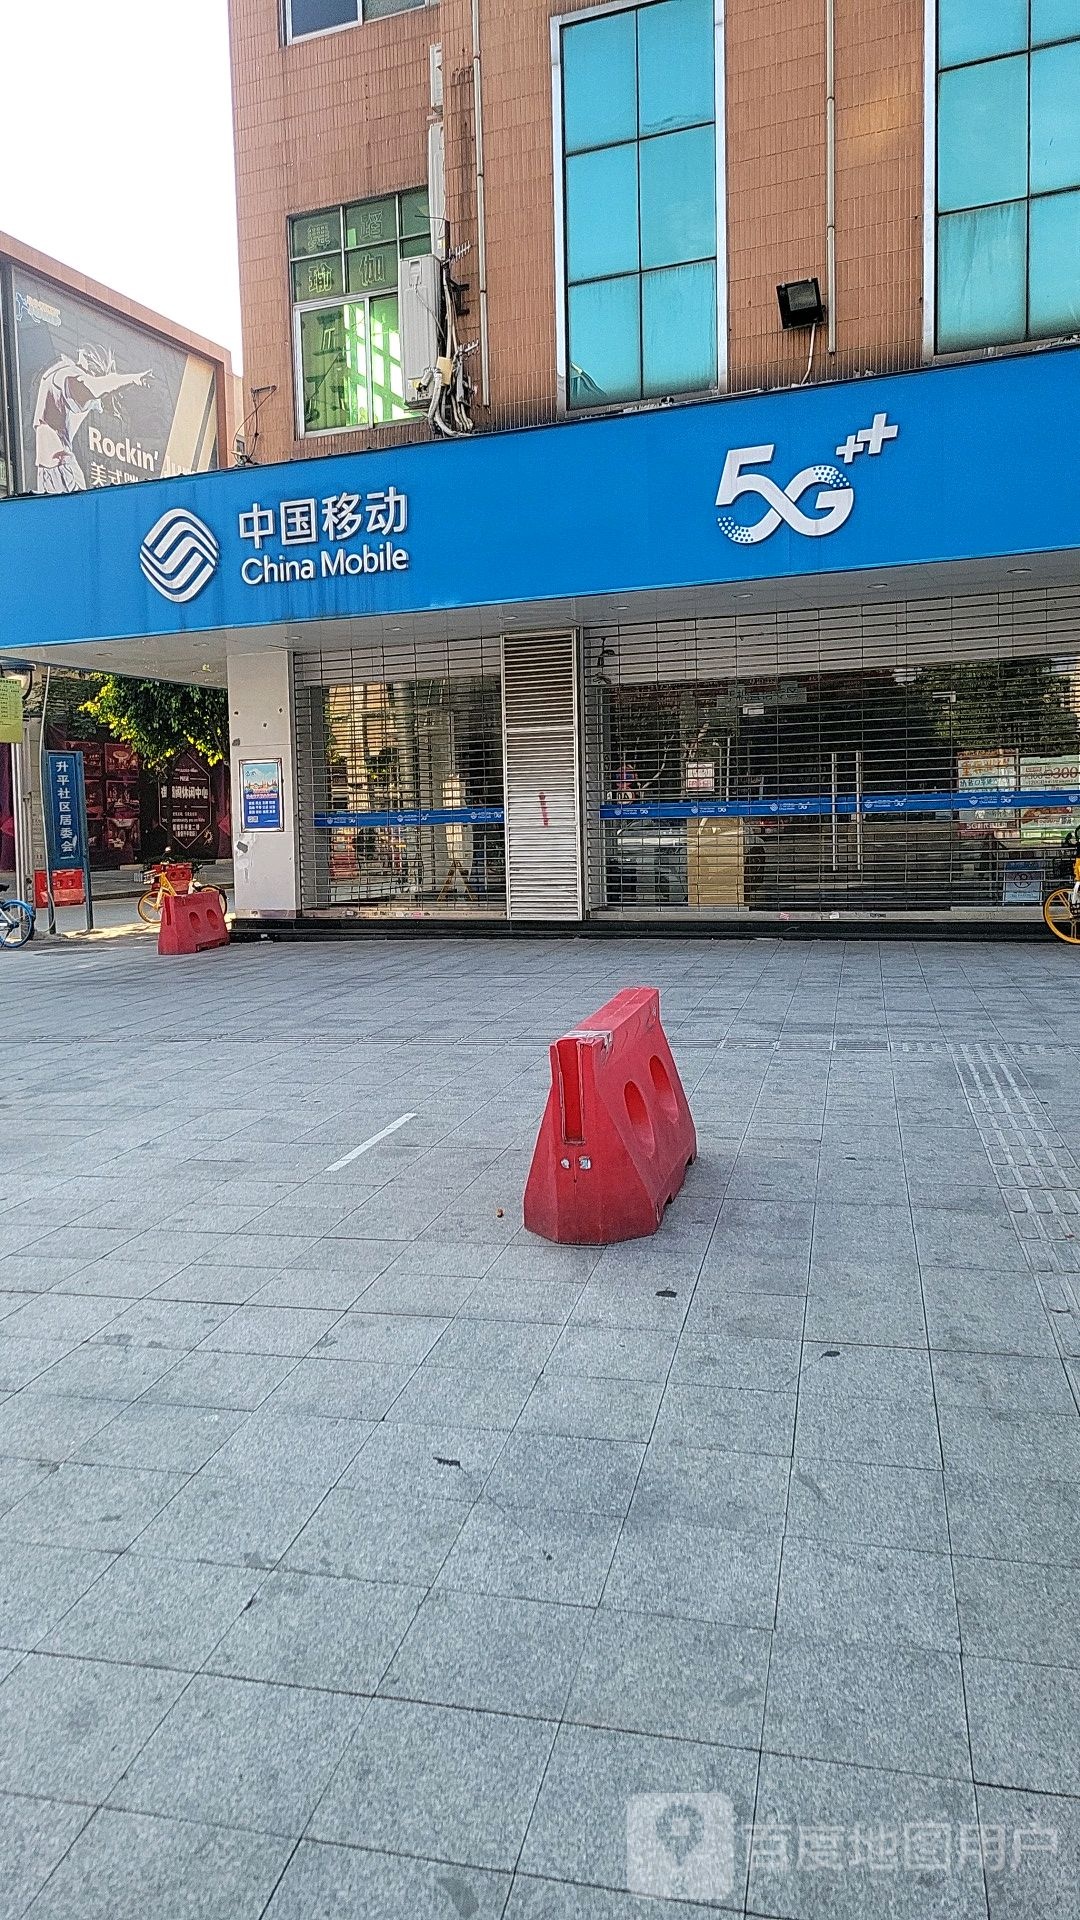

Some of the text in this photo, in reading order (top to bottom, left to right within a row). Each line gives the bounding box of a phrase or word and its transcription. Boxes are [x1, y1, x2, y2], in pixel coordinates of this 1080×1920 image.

[88, 426, 159, 472] Rockin'
[239, 486, 408, 549] 中国移动
[241, 541, 409, 585] China Mobile
[55, 761, 74, 852] 升平社区居委会
